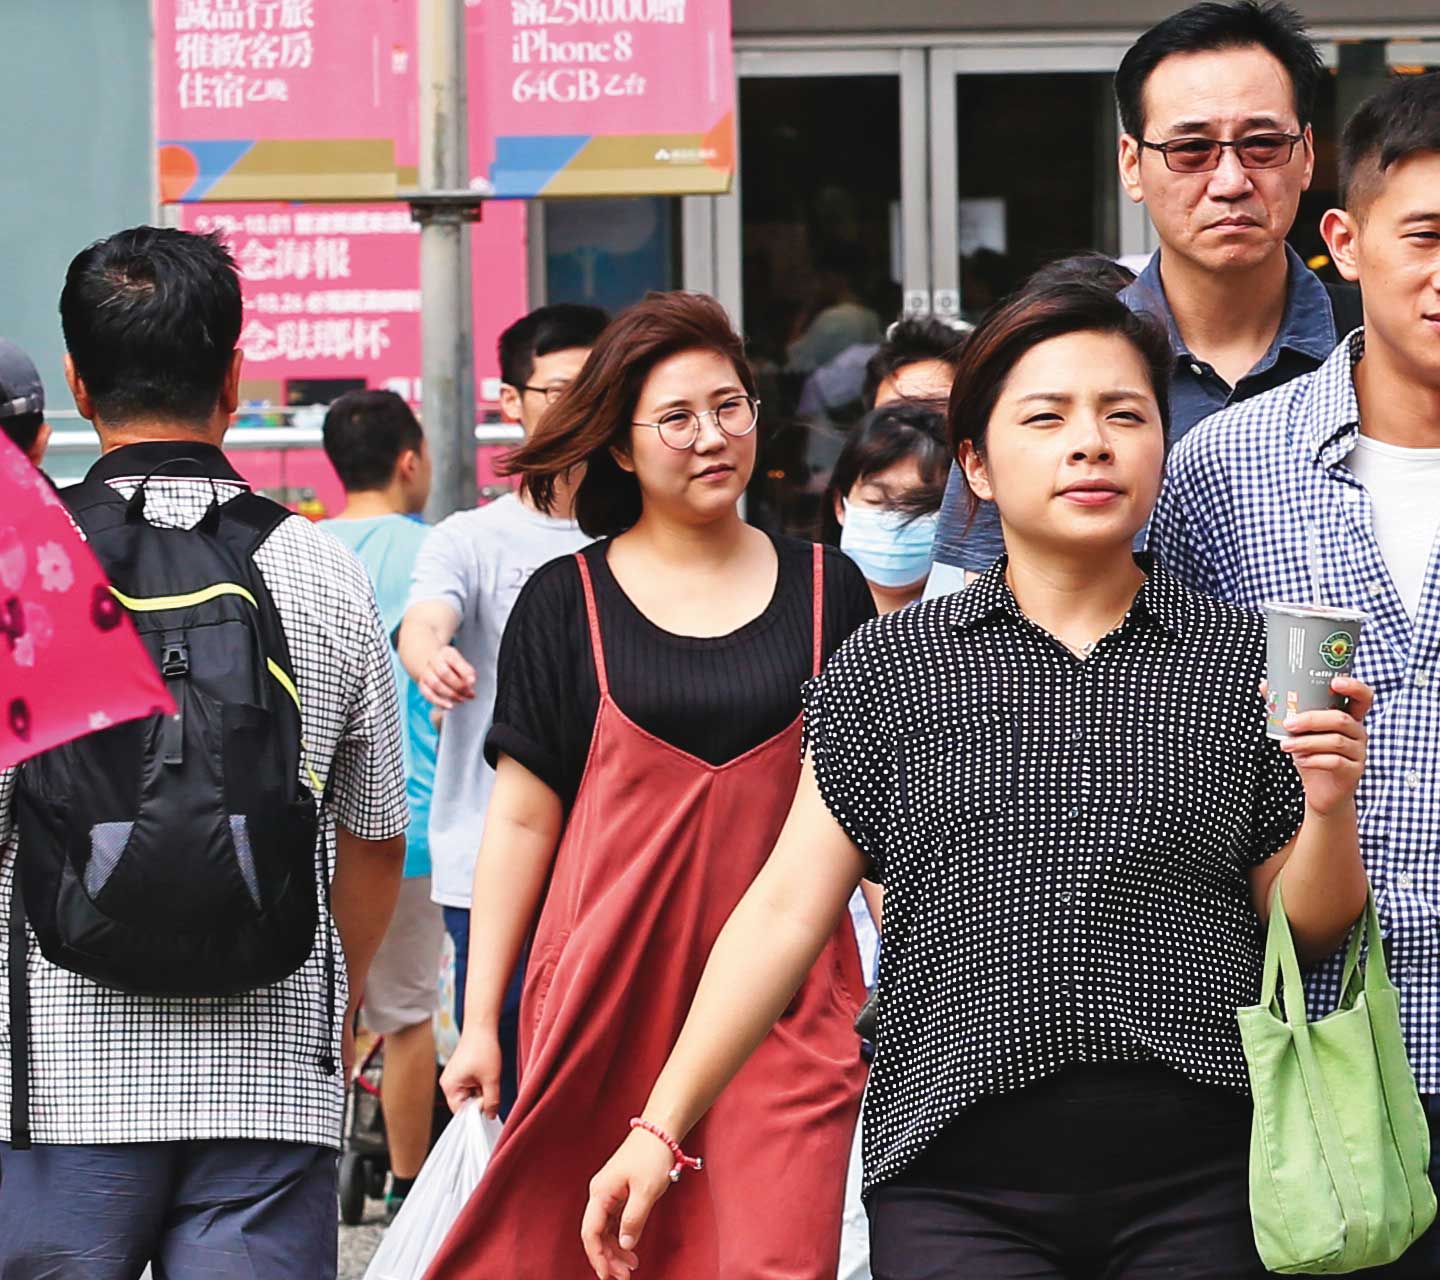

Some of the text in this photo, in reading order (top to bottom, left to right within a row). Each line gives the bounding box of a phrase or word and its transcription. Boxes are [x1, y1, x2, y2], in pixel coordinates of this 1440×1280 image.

[511, 29, 633, 63] iPhone 8
[512, 69, 600, 102] 64GB
[228, 237, 353, 280] 念海報
